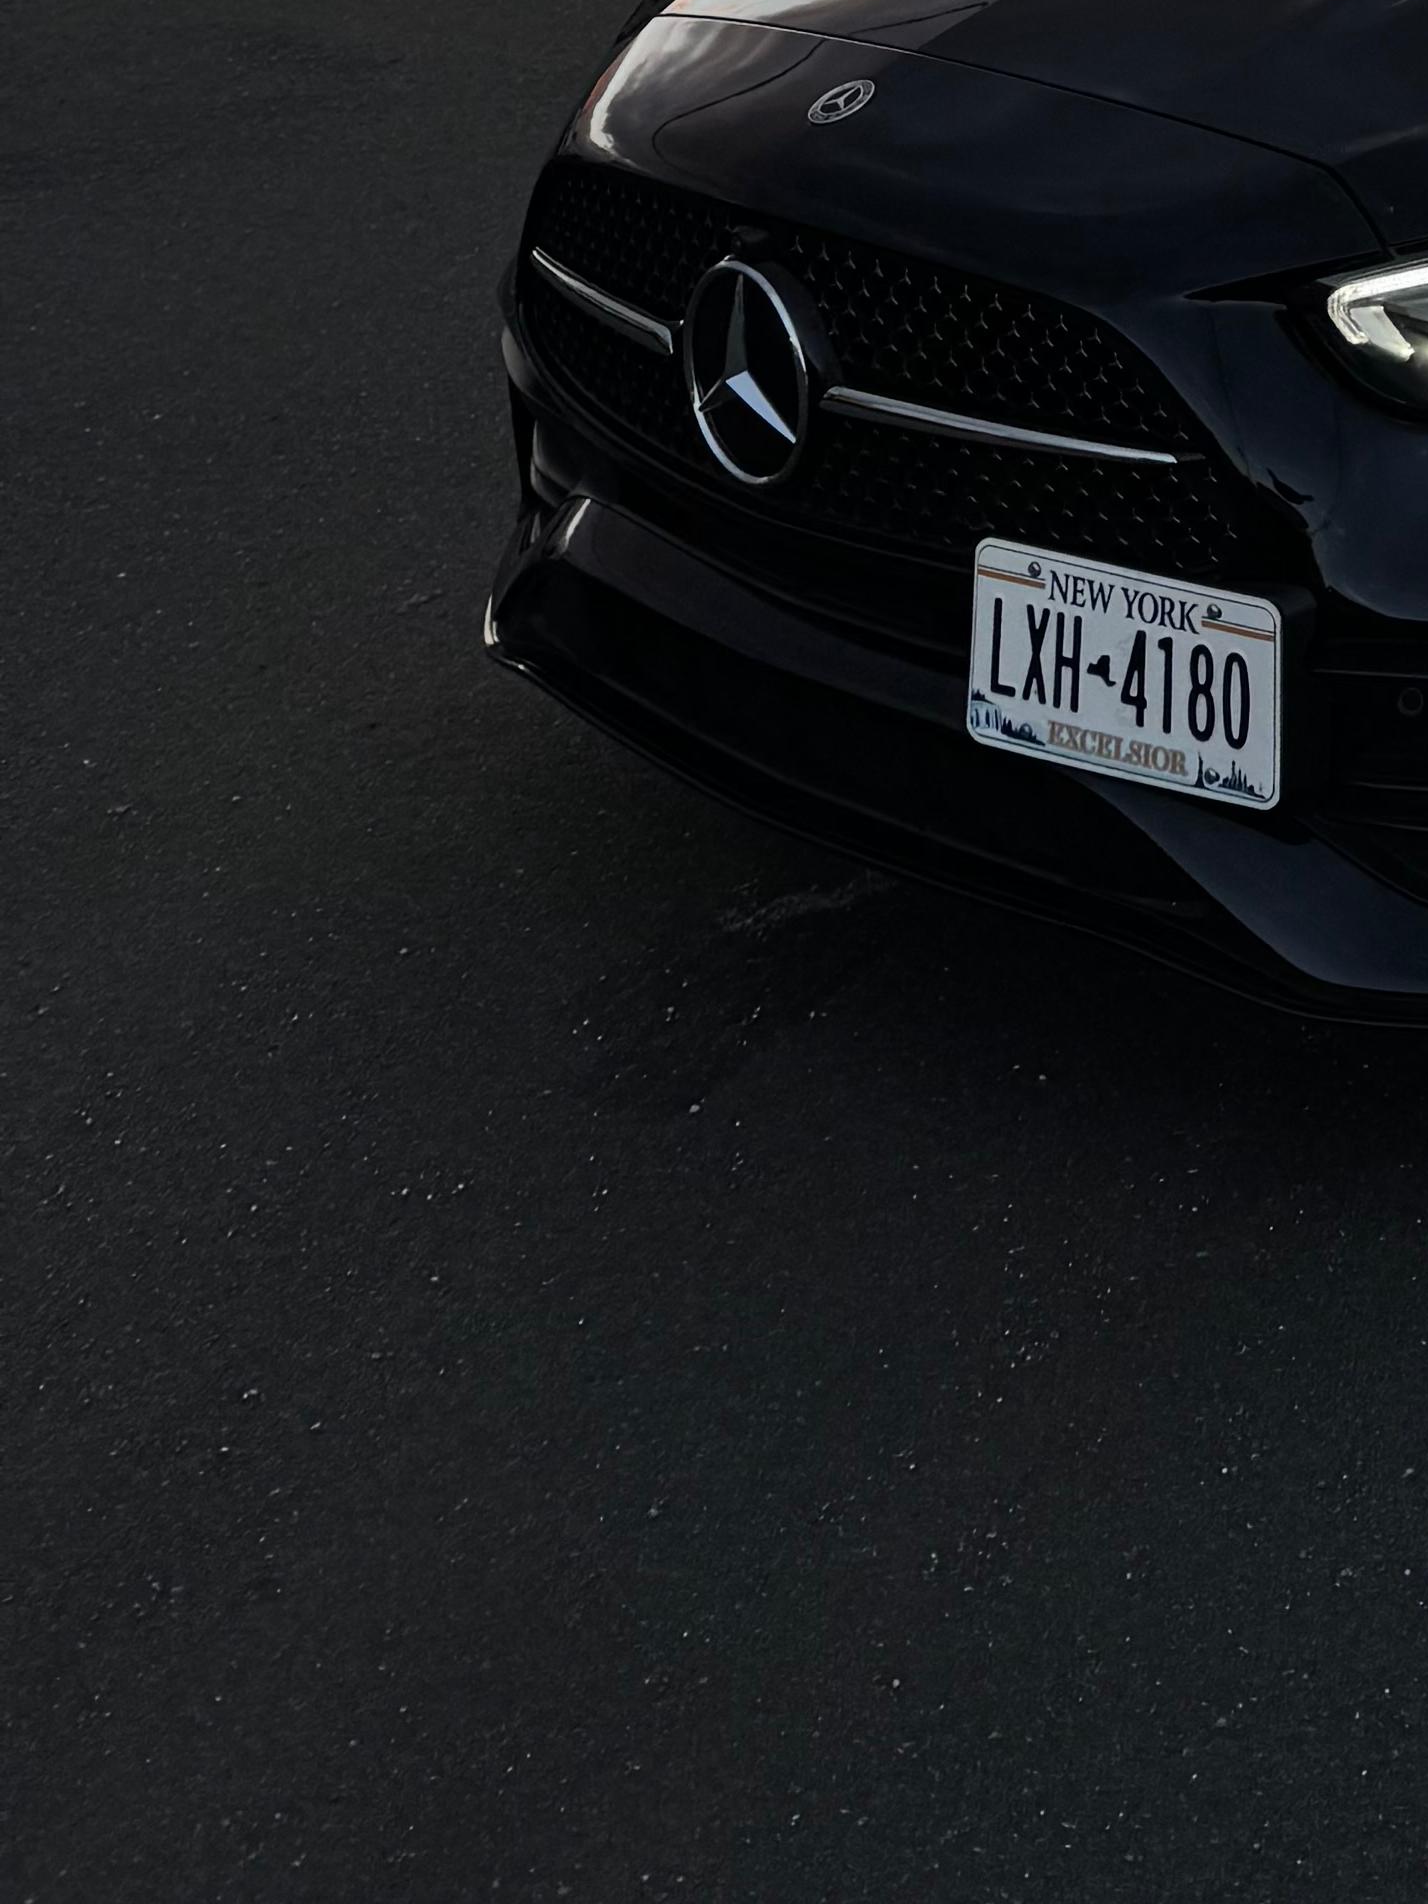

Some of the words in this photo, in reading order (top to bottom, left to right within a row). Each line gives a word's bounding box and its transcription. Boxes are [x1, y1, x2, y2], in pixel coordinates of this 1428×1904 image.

[1048, 569, 1116, 614] NEW
[1121, 587, 1201, 634] YORK
[990, 597, 1082, 712] LXH
[1120, 630, 1251, 750] 4180
[1046, 719, 1188, 777] EXCELSIOR
